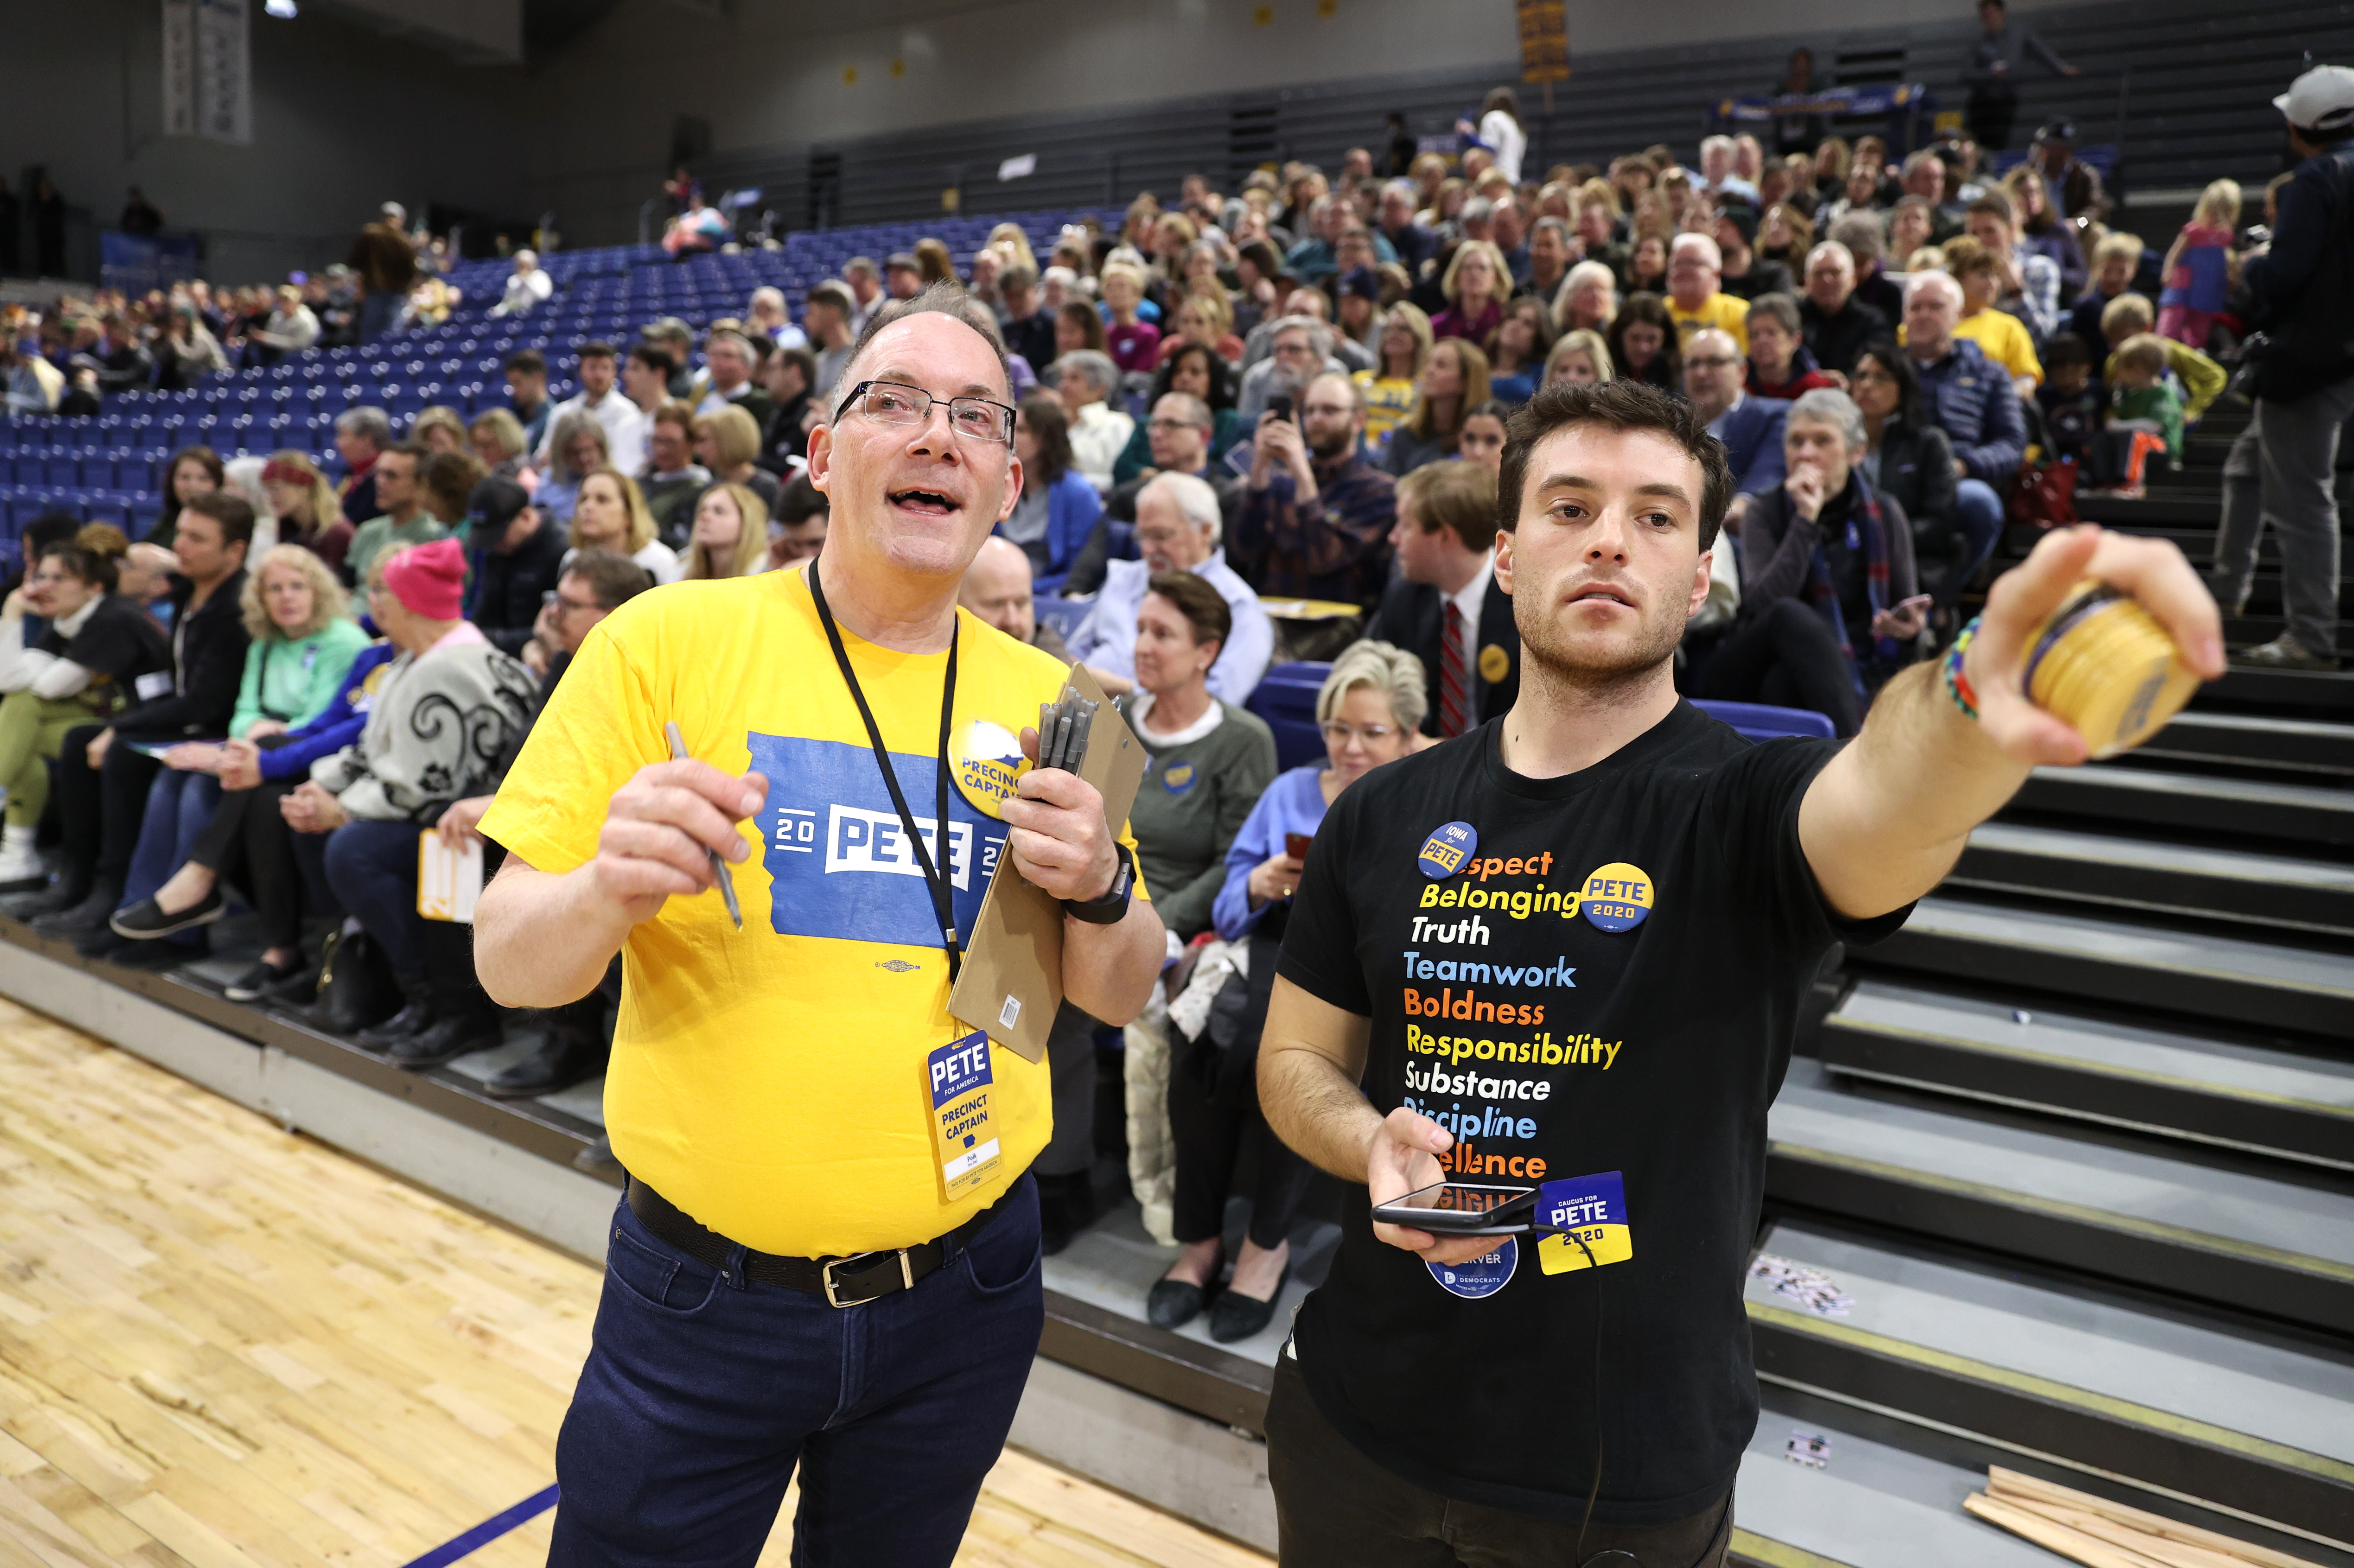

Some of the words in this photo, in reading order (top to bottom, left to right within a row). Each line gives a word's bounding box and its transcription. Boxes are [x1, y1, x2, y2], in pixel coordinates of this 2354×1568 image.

[963, 757, 1019, 788] PRECIN
[964, 774, 1021, 799] CAPTA
[777, 819, 814, 842] 20
[837, 816, 964, 875] PETE
[982, 847, 997, 867] 2
[1446, 825, 1468, 841] IOWA
[1424, 842, 1460, 866] PETE
[1457, 851, 1553, 881] spect
[1419, 881, 1581, 919] Belonging
[1588, 878, 1646, 901] PETE
[1593, 904, 1635, 918] 2020
[1411, 915, 1490, 945] Truth
[1403, 951, 1577, 987] Teamwork
[1404, 988, 1545, 1025] Boldness
[1407, 1024, 1622, 1070] Responsibility
[931, 1042, 986, 1092] PETE
[1405, 1060, 1550, 1100] Substance
[945, 1086, 955, 1096] FOR
[956, 1075, 979, 1091] AMERICA
[942, 1094, 987, 1126] PRECINCT
[946, 1110, 987, 1139] CAPTAIN
[967, 1153, 977, 1162] Polk
[984, 1160, 997, 1170] AMERICA
[1433, 1142, 1547, 1178] ellence
[1551, 1200, 1608, 1226] PETE
[1558, 1198, 1583, 1207] CAUCUS
